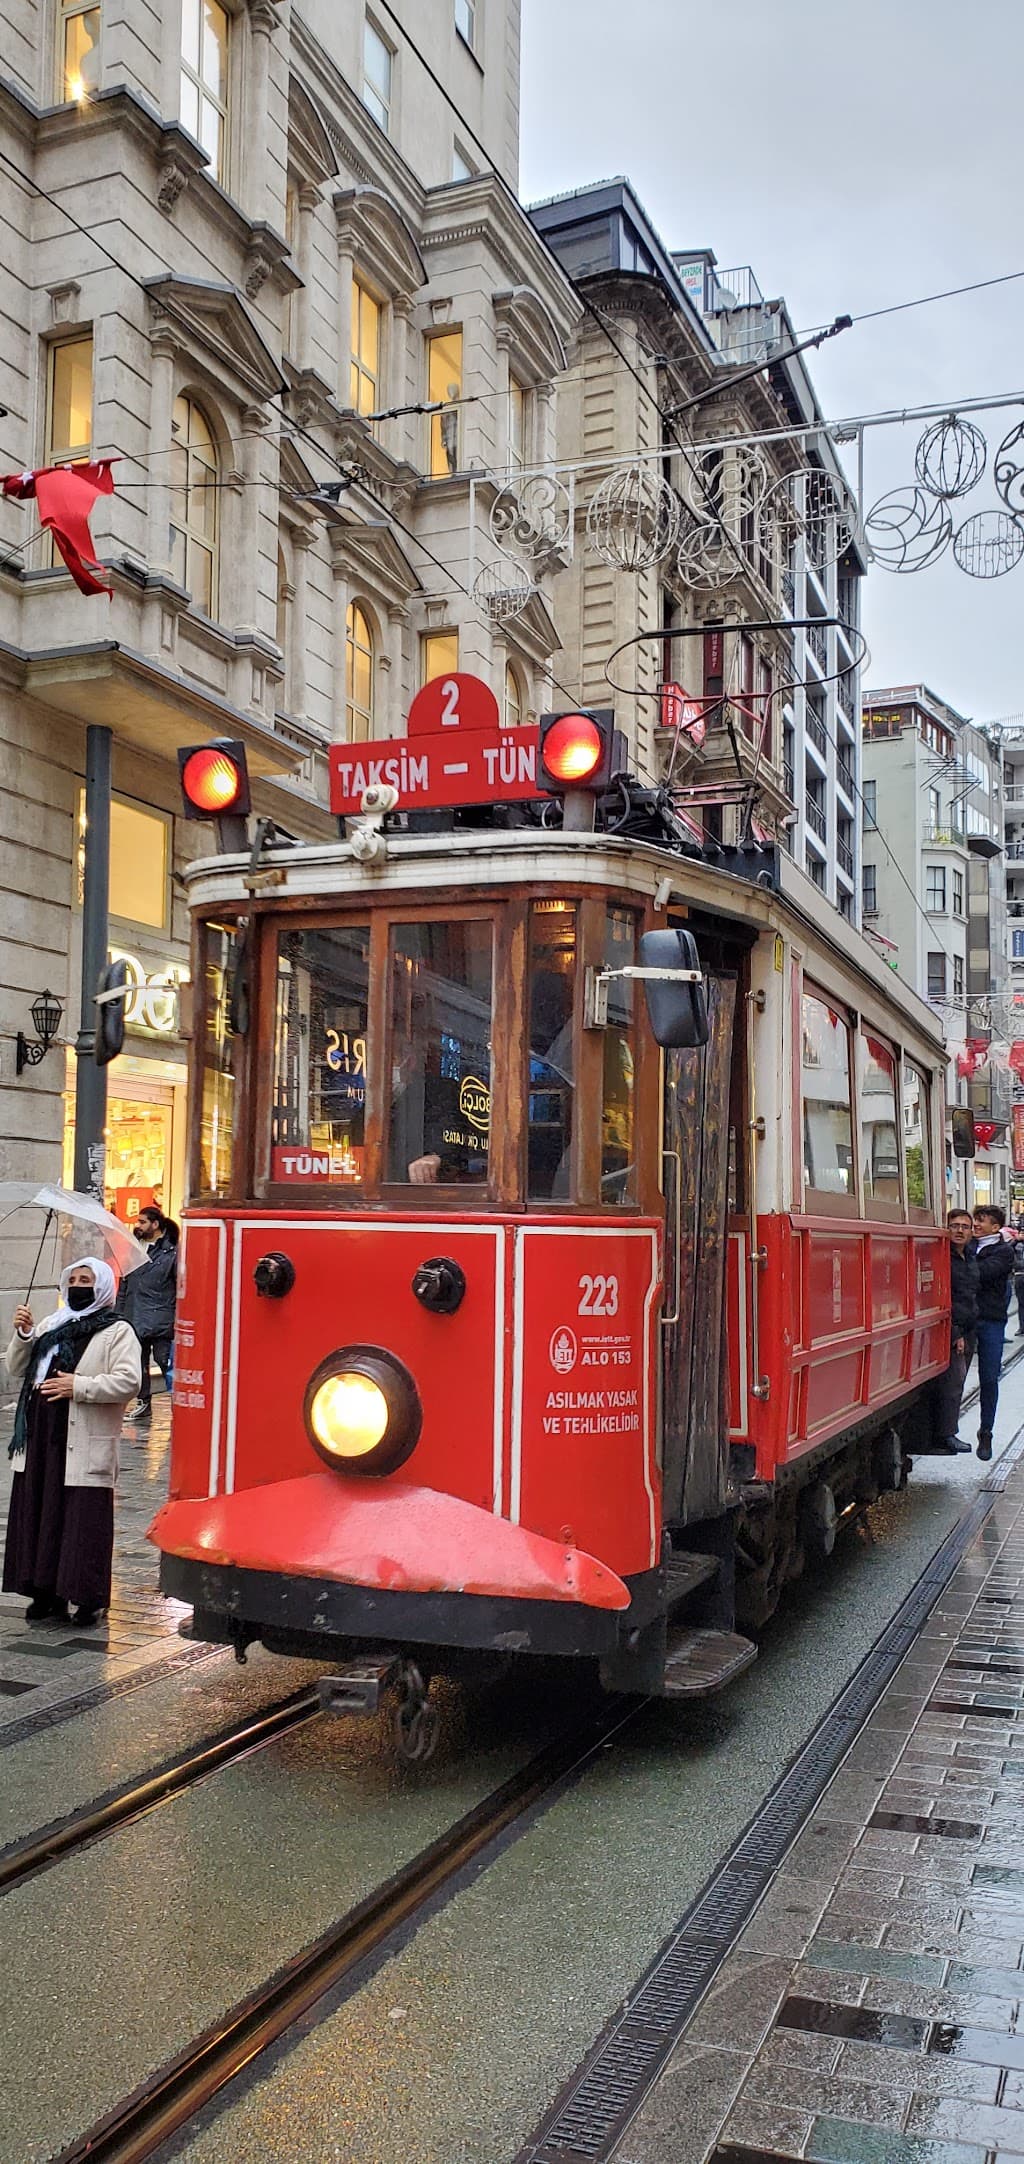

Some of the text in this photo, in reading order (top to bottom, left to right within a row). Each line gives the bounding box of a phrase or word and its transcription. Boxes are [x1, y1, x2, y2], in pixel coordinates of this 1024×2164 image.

[441, 679, 460, 726] 2
[338, 747, 429, 798] TAKSİM
[483, 736, 536, 786] TÜN
[281, 1153, 357, 1175] TÜNEL
[578, 1274, 618, 1316] 223
[581, 1350, 632, 1366] ALO 153
[546, 1389, 638, 1409] ASILMAK YASAK
[542, 1410, 640, 1434] VE TEHLİKELİDİR
